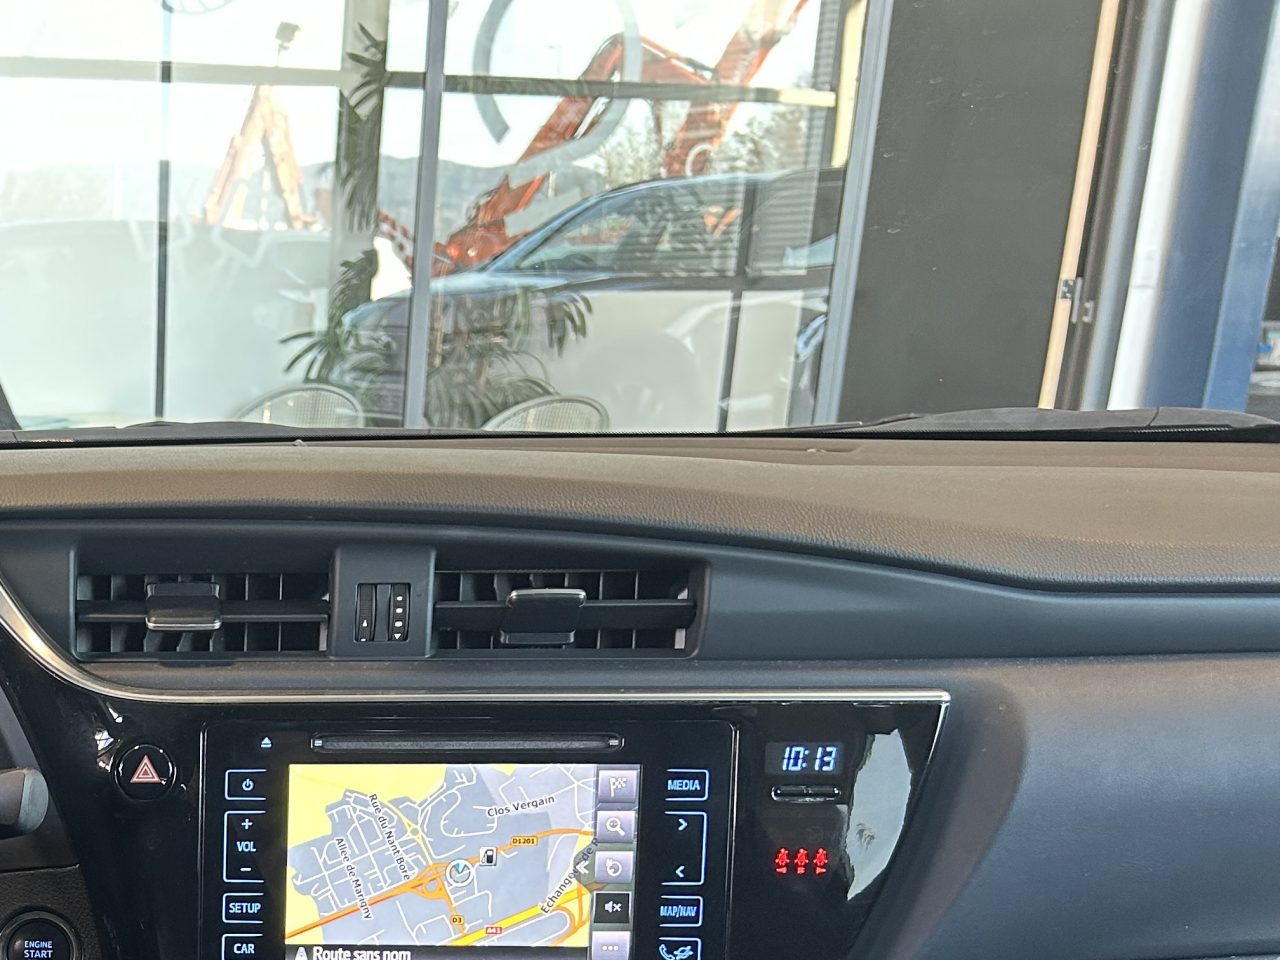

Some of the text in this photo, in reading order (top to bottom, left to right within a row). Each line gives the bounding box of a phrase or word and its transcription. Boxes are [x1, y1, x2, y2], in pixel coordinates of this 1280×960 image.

[782, 746, 839, 771] 10:13
[667, 779, 701, 791] MEDIA
[487, 796, 555, 817] Clos Vergain
[369, 793, 381, 814] Rue
[378, 816, 388, 829] du
[385, 830, 401, 855] Nant
[236, 841, 257, 852] VOL
[581, 847, 594, 861] de
[346, 864, 356, 877] de
[352, 878, 372, 919] Marigny
[229, 902, 262, 914] SETUP
[660, 905, 698, 918] MAP/NAV
[24, 940, 53, 949] ENGINE
[233, 943, 255, 954] CAR
[23, 950, 53, 958] START
[312, 946, 412, 960] Route sans nom
